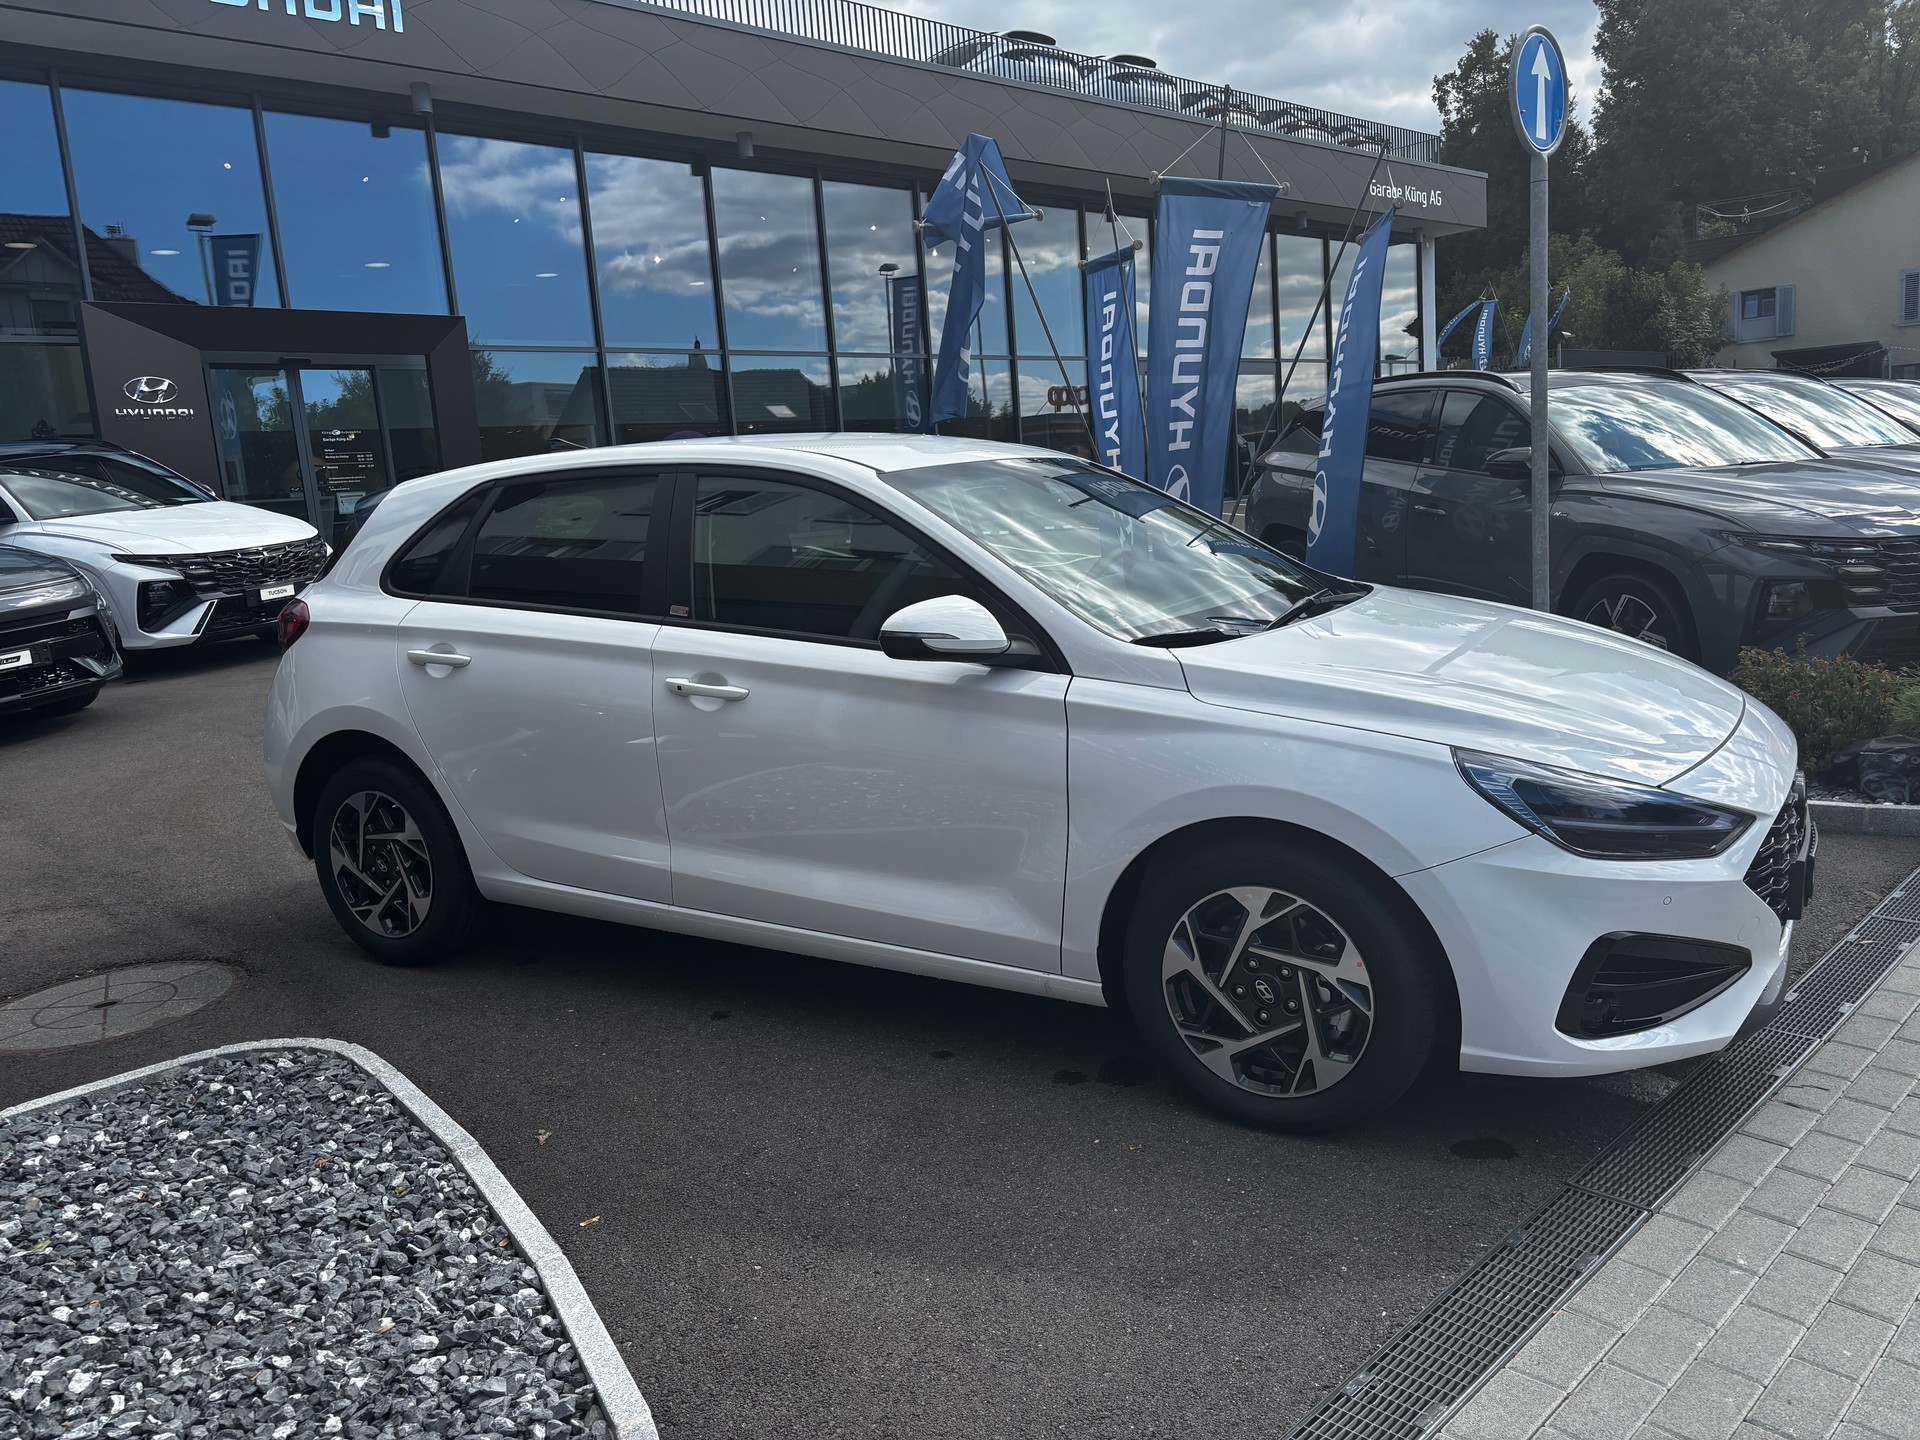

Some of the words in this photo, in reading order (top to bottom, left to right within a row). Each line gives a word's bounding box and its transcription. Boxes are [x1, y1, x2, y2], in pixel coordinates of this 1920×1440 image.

[1404, 184, 1428, 208] Küng
[1429, 189, 1442, 206] AG
[115, 408, 194, 420] HYUNDAI
[267, 588, 288, 596] TUCSON
